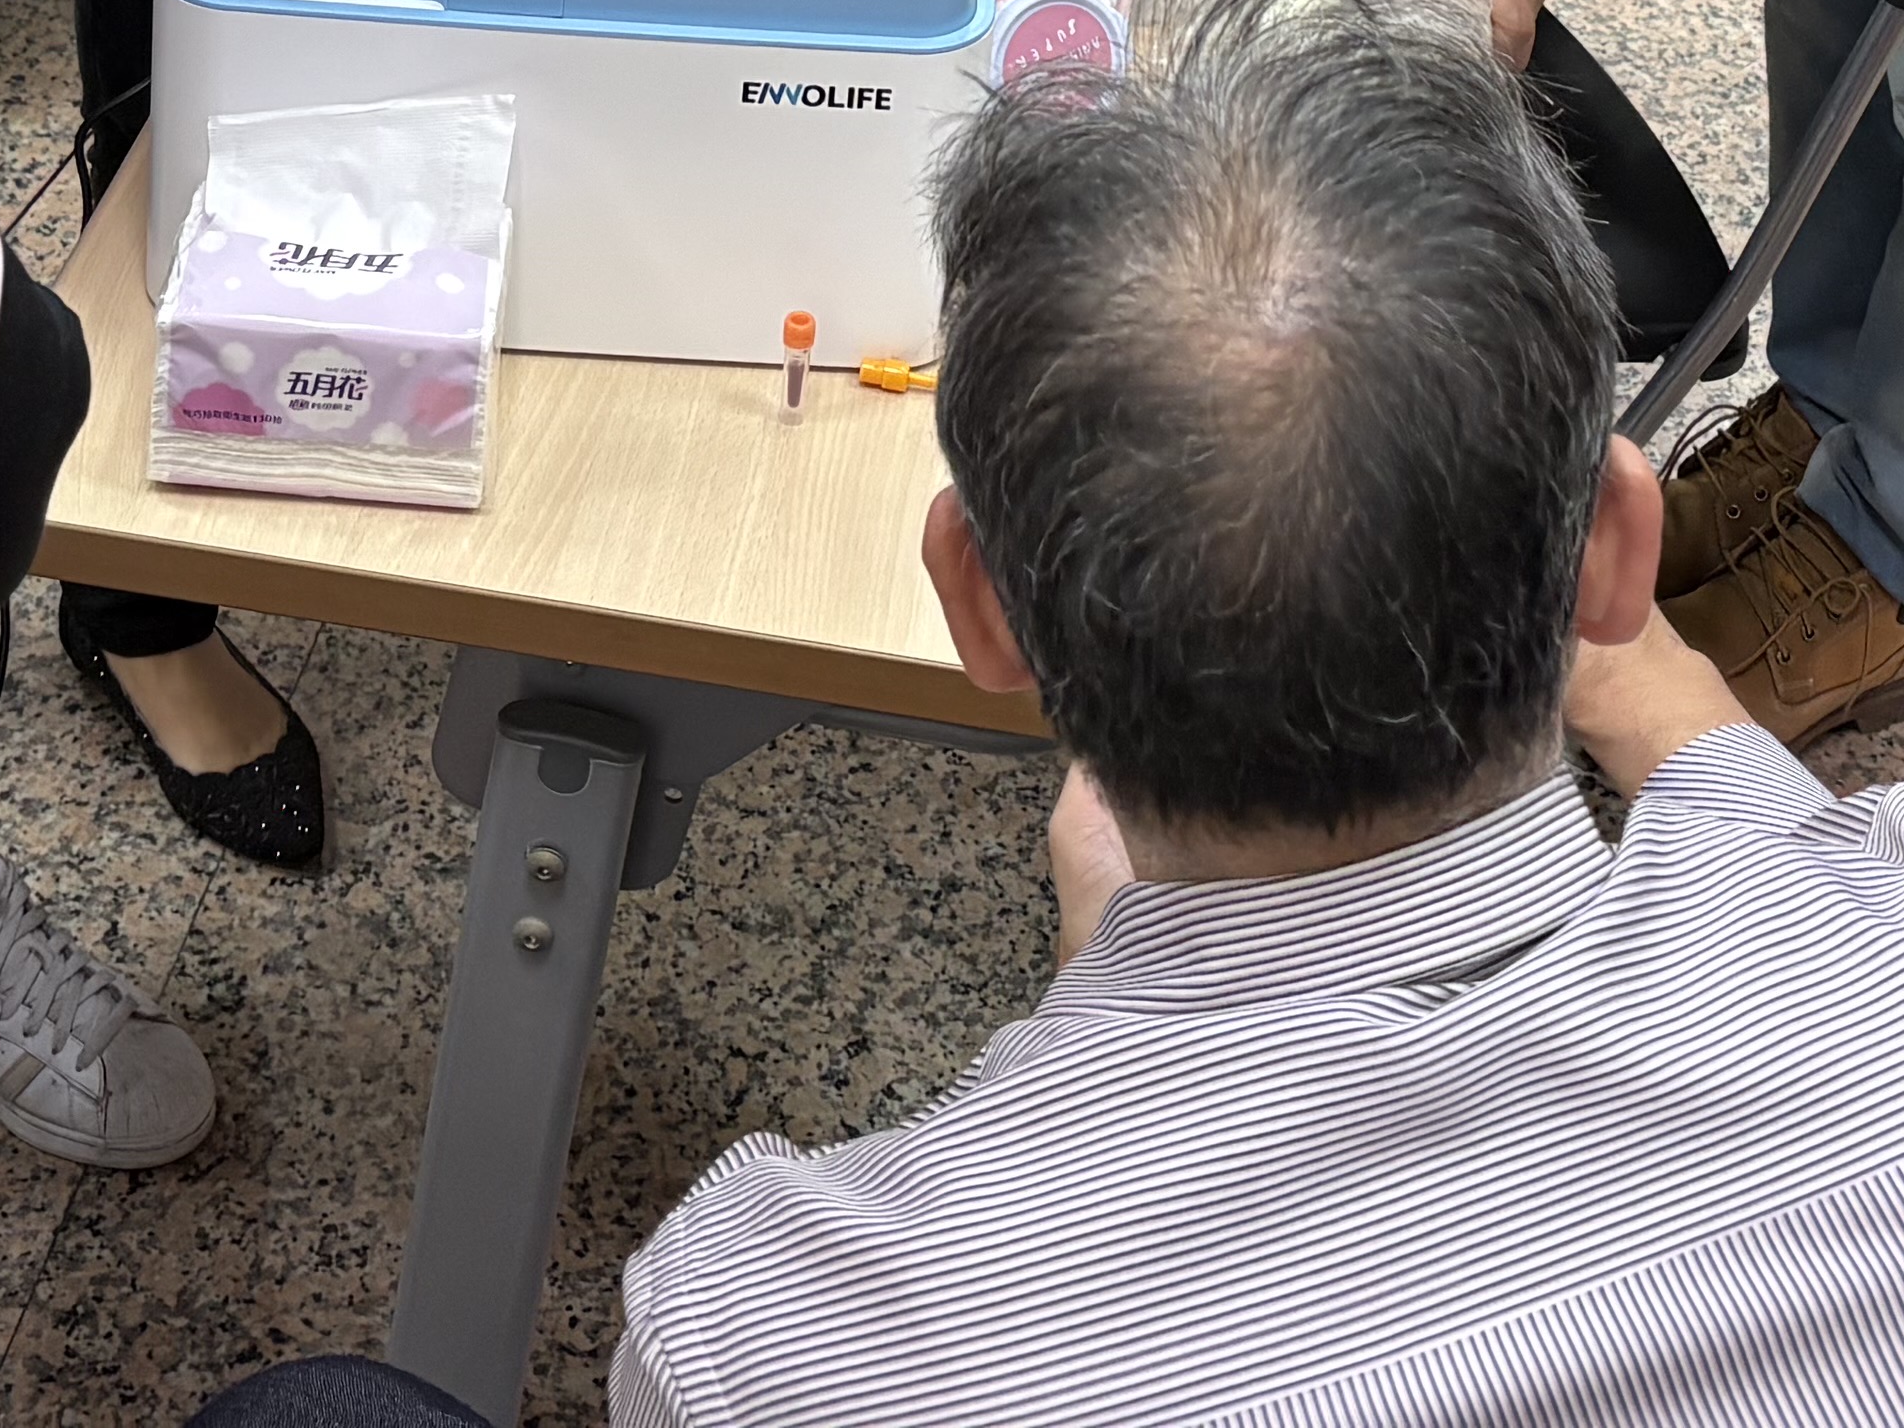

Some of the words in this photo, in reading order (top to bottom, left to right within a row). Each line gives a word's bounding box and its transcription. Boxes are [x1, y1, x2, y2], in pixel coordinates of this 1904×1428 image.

[269, 241, 404, 275] 五月花
[283, 371, 369, 401] 五月花
